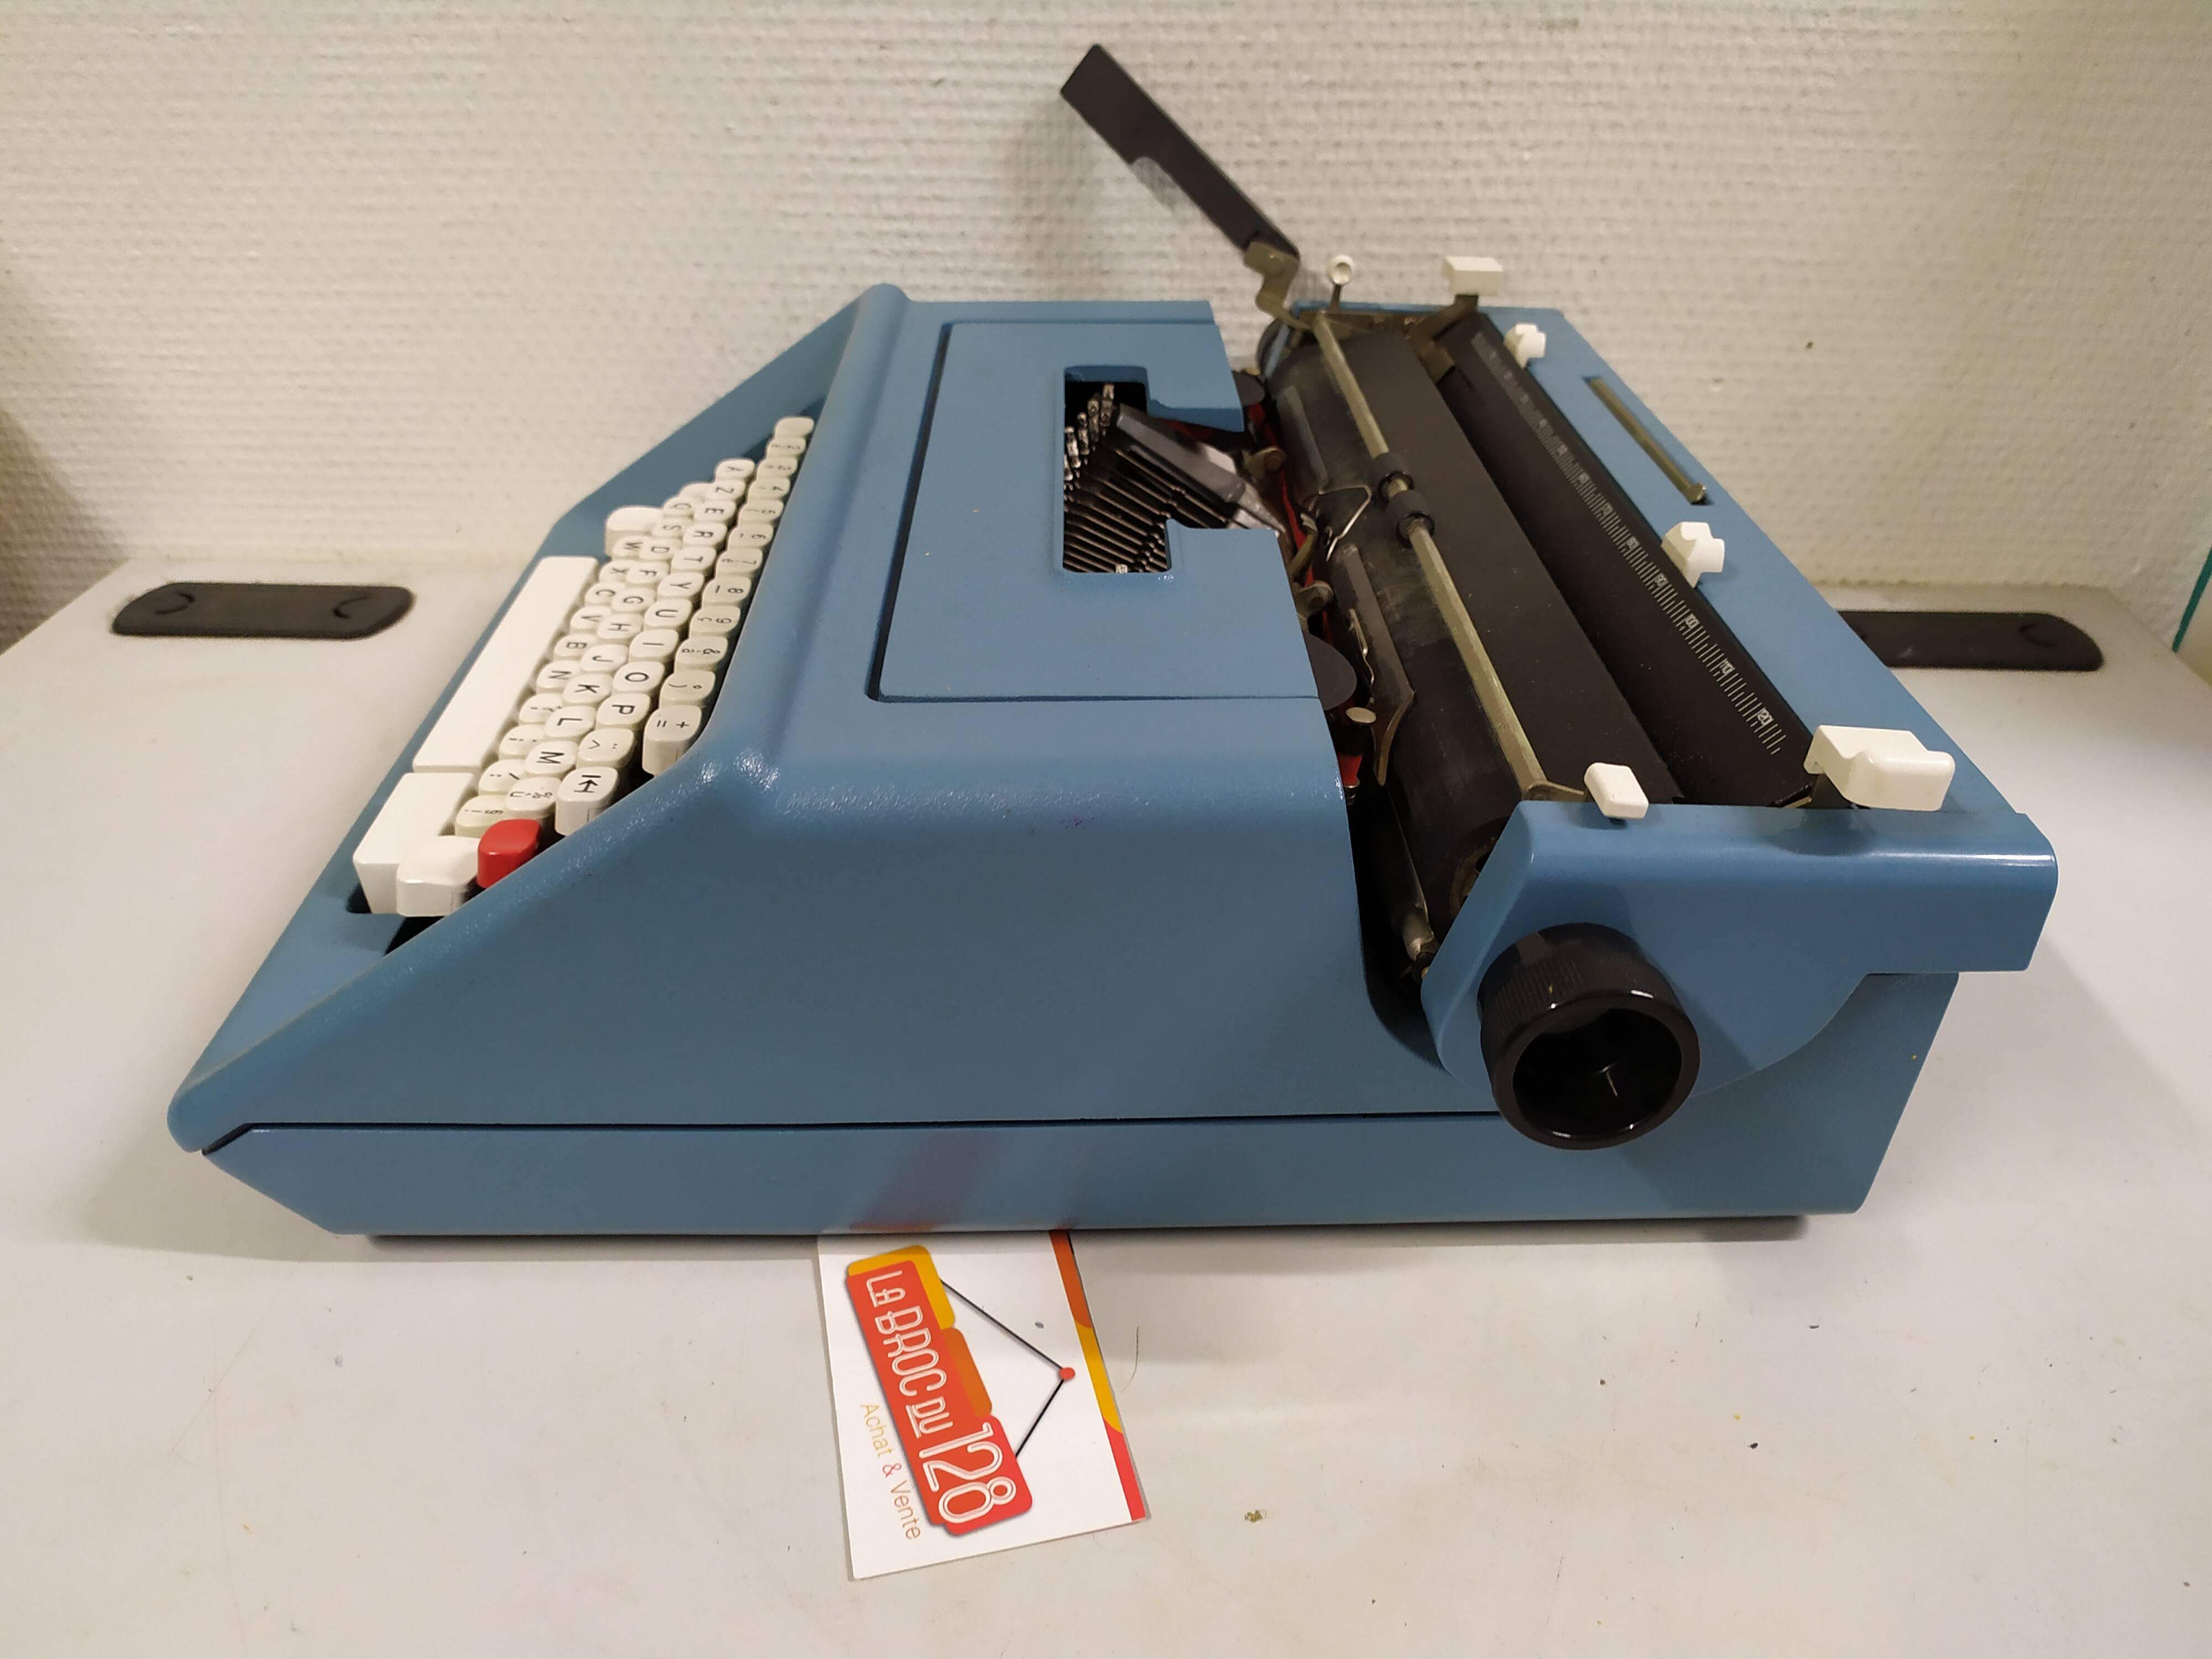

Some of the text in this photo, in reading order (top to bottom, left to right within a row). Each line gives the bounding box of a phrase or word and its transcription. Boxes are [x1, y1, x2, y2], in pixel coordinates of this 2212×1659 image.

[624, 541, 644, 550] W
[1654, 573, 1668, 587] 90
[595, 589, 616, 597] C
[623, 596, 644, 604] G
[655, 608, 679, 618] U
[1685, 613, 1699, 629] 100
[607, 623, 632, 632] H
[566, 641, 588, 650] B
[592, 655, 614, 663] J
[1720, 658, 1735, 676] 110
[548, 670, 572, 680] N
[624, 671, 650, 682] O
[575, 684, 601, 694] K
[611, 704, 636, 715] P
[557, 717, 583, 726] L
[1757, 707, 1774, 726] 120
[675, 721, 690, 729] +
[536, 750, 565, 764] M
[865, 1270, 1017, 1524] LA BROC DU 128
[860, 1403, 921, 1540] Achat & Vente
